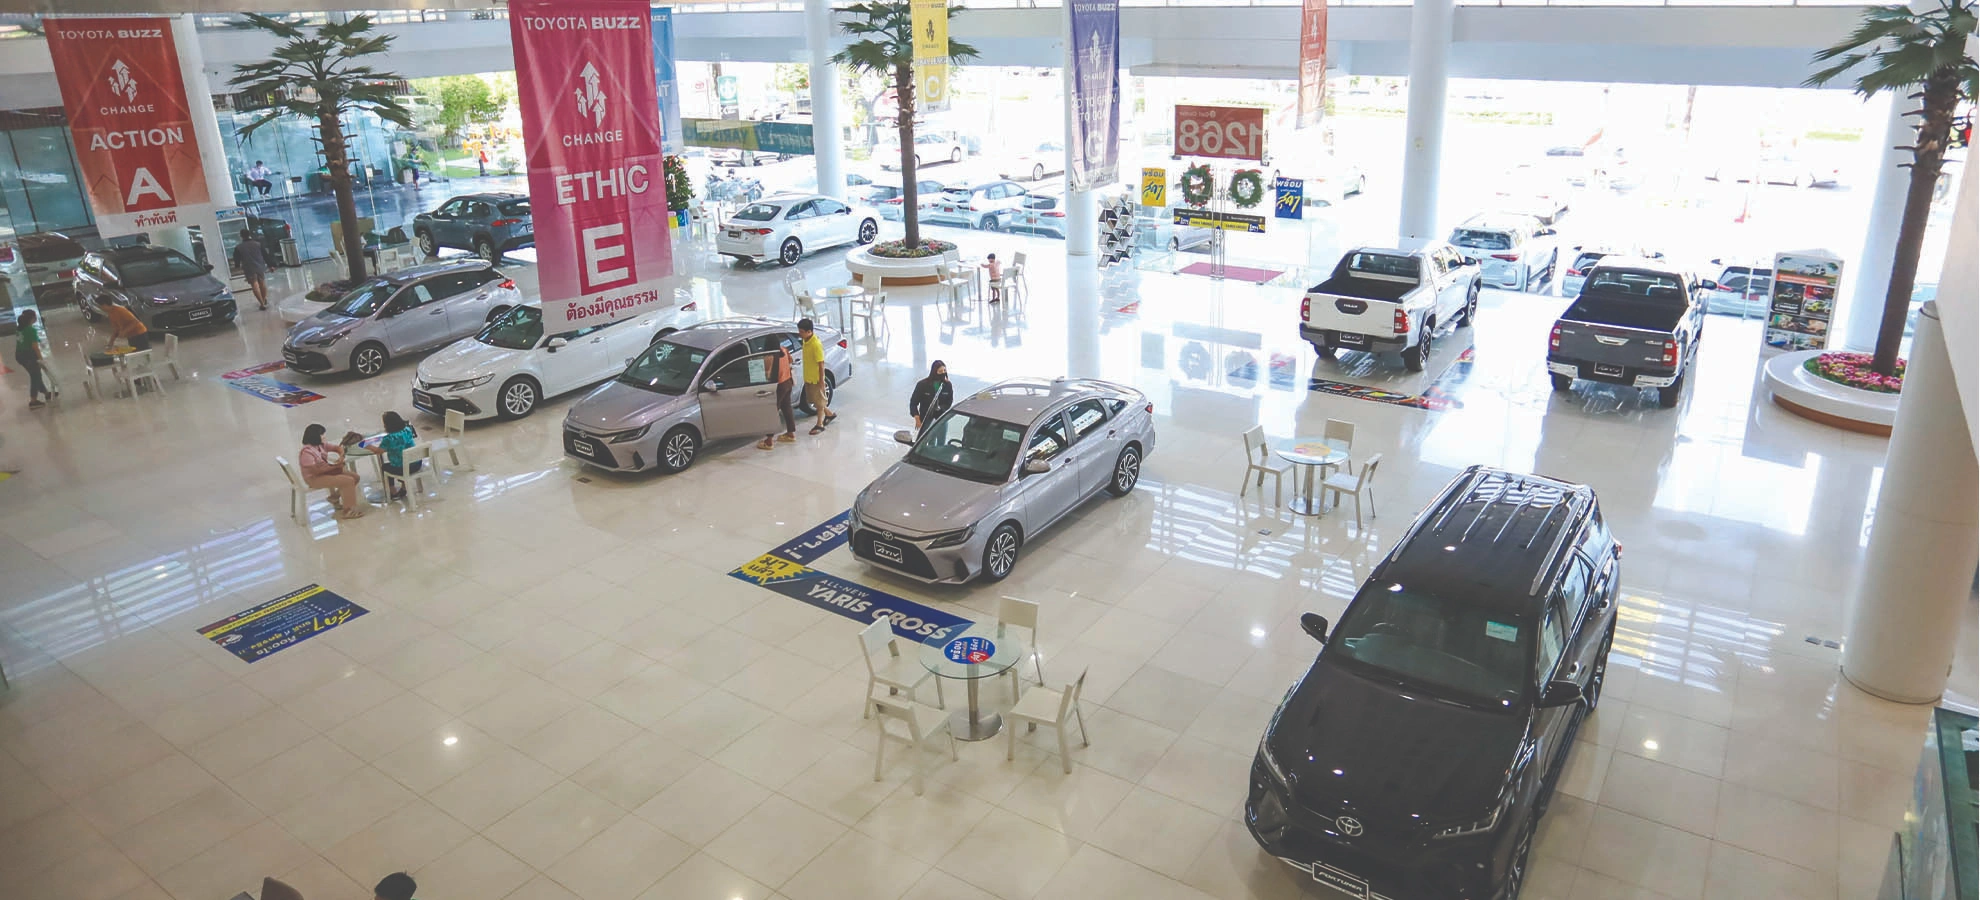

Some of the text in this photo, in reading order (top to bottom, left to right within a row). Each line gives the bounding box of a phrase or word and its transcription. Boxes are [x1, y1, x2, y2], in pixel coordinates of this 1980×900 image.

[1073, 2, 1117, 12] TOYOTA BUZZ
[524, 16, 641, 31] TOYOTA BUZZ
[57, 29, 163, 40] TOYOTA BUZZ
[925, 76, 940, 98] C
[100, 104, 155, 115] CHANGE
[90, 126, 184, 151] ACTION
[563, 129, 623, 147] CHANGE
[127, 167, 172, 206] A
[555, 165, 649, 205] ETHIC
[1276, 177, 1302, 188] พร้อม
[135, 209, 177, 228] ทำทันที
[582, 223, 629, 287] E
[566, 289, 658, 321] ต้องมีคุณธรรม
[821, 579, 870, 598] ALL-NEW
[806, 584, 952, 640] YARIS CROSS
[1318, 871, 1363, 892] FORTUNER
